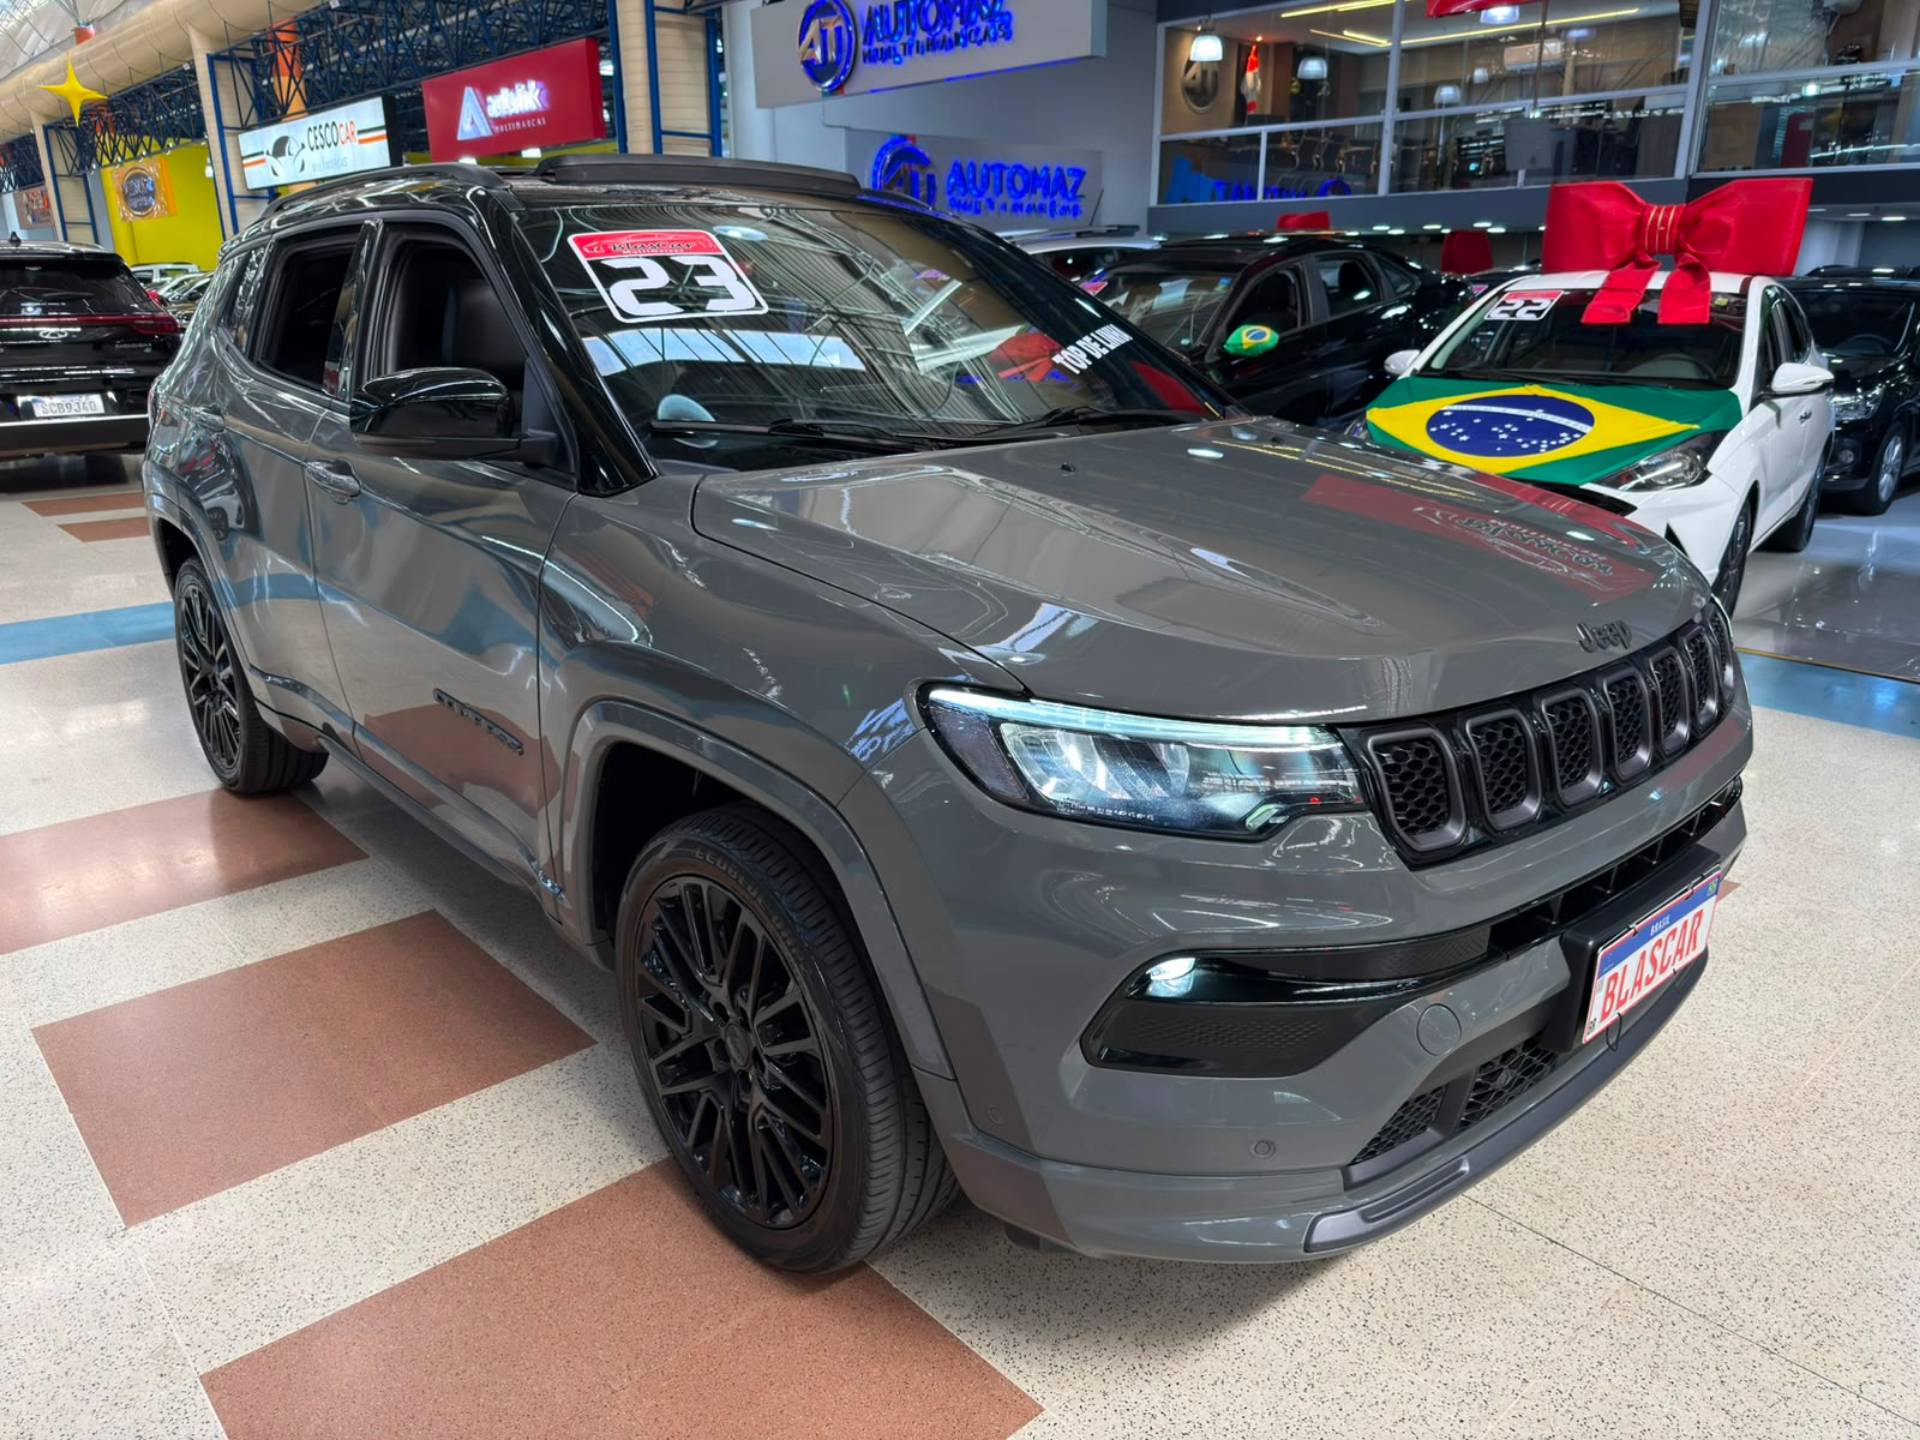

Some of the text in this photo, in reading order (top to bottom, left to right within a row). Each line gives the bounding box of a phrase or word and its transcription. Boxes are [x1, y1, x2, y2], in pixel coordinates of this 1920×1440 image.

[947, 160, 1086, 201] AUTOMAZ
[600, 256, 757, 316] 23
[1489, 298, 1552, 319] 22
[1051, 345, 1093, 375] TOP
[1075, 335, 1110, 359] DE
[1576, 620, 1632, 653] Jeep
[1601, 908, 1704, 1022] BLASCAR
